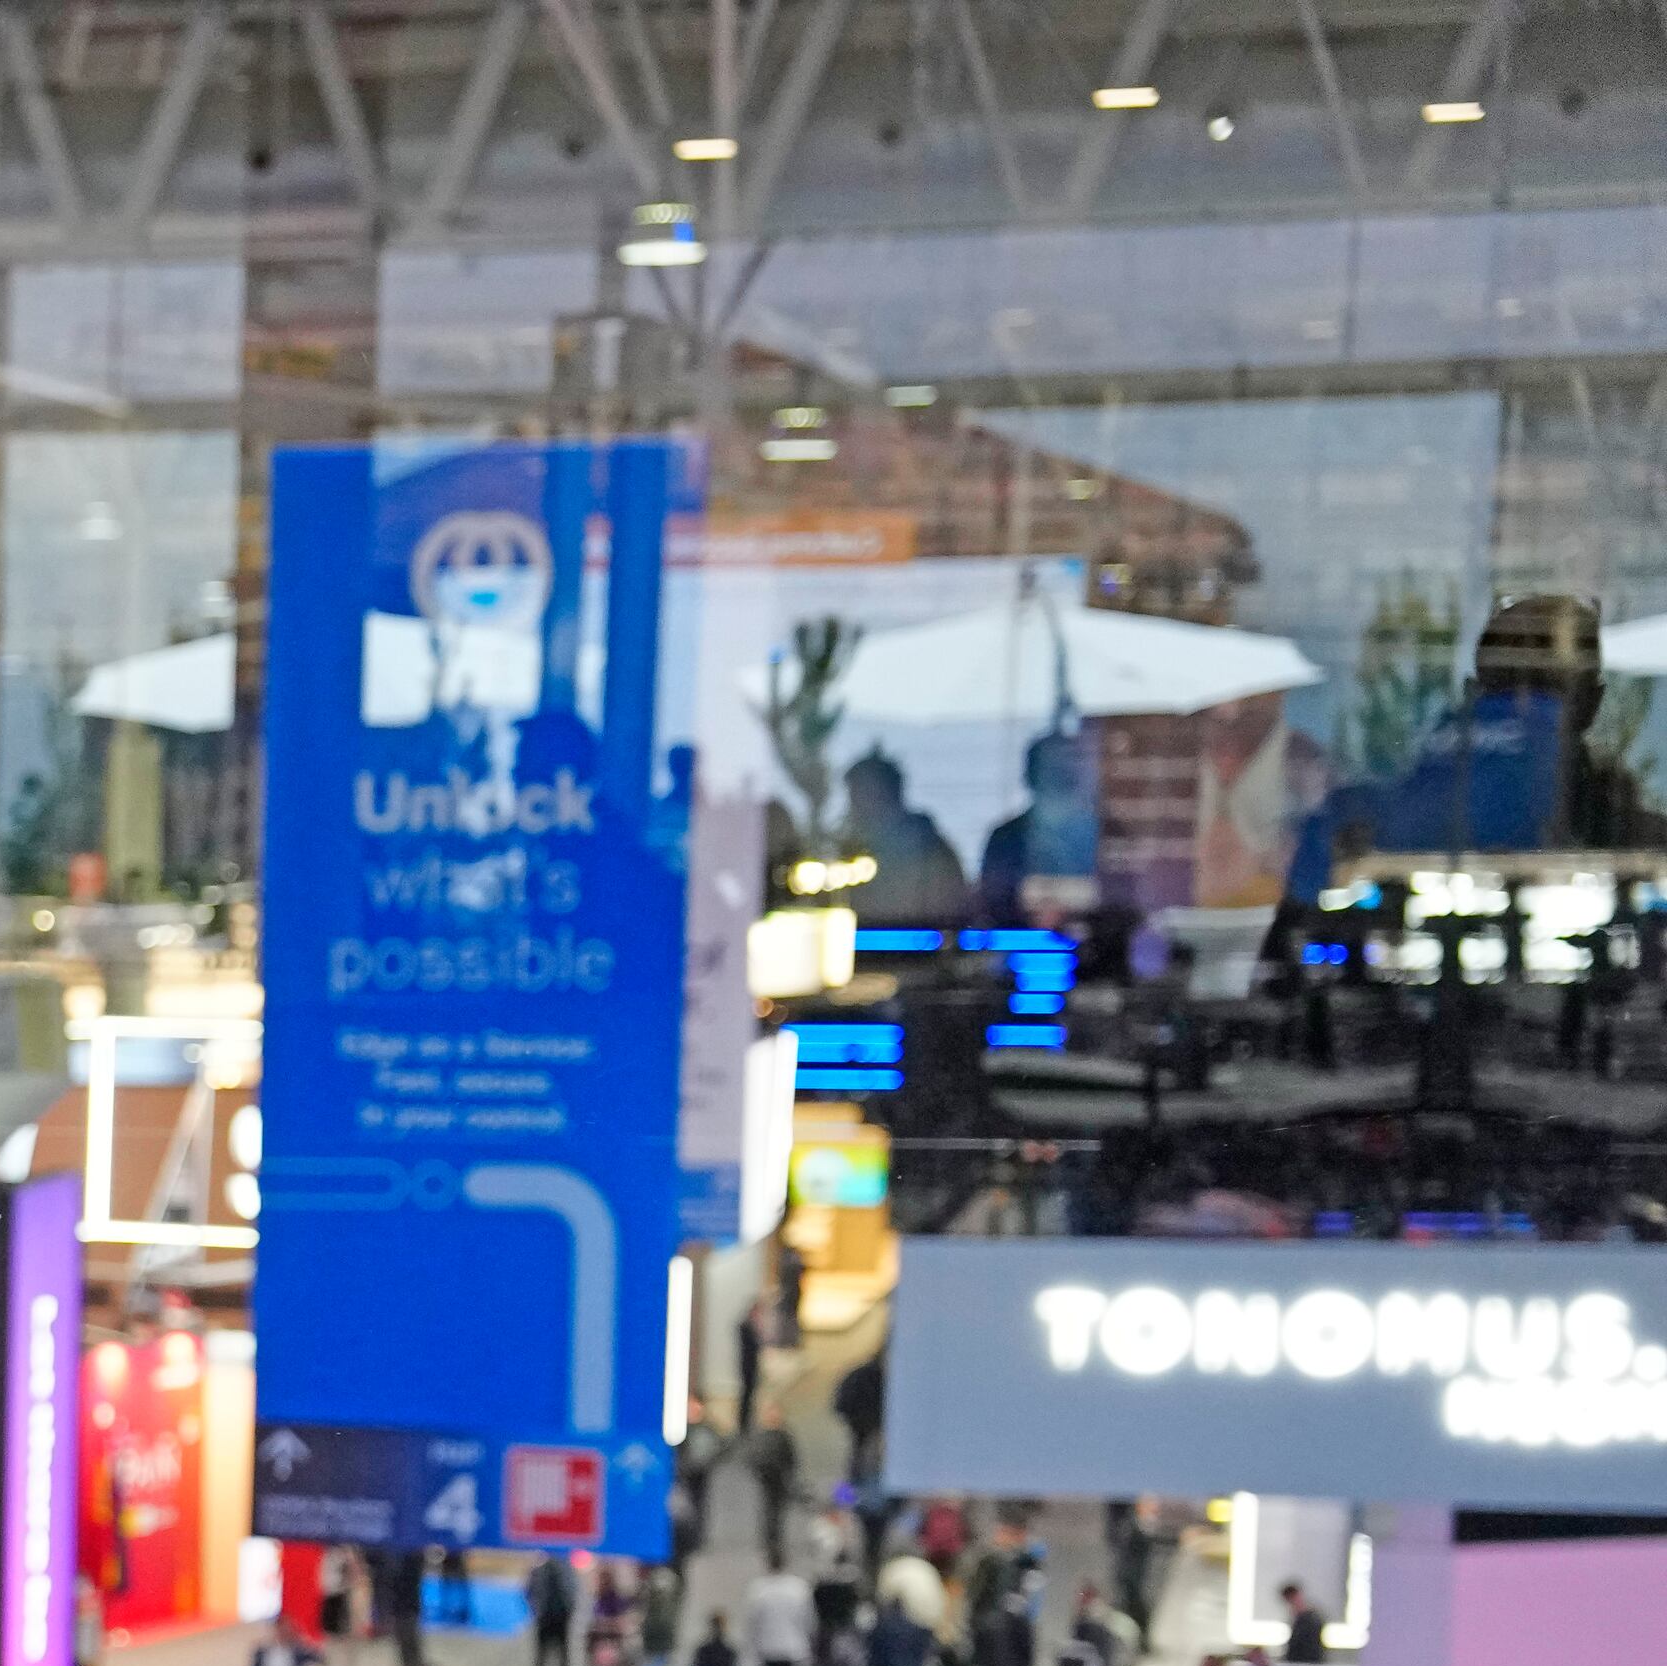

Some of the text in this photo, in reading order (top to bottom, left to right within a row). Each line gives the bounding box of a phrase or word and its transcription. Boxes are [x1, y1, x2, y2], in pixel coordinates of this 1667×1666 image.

[353, 766, 596, 834] Unlock
[328, 925, 616, 1001] possible
[423, 1473, 484, 1543] 4
